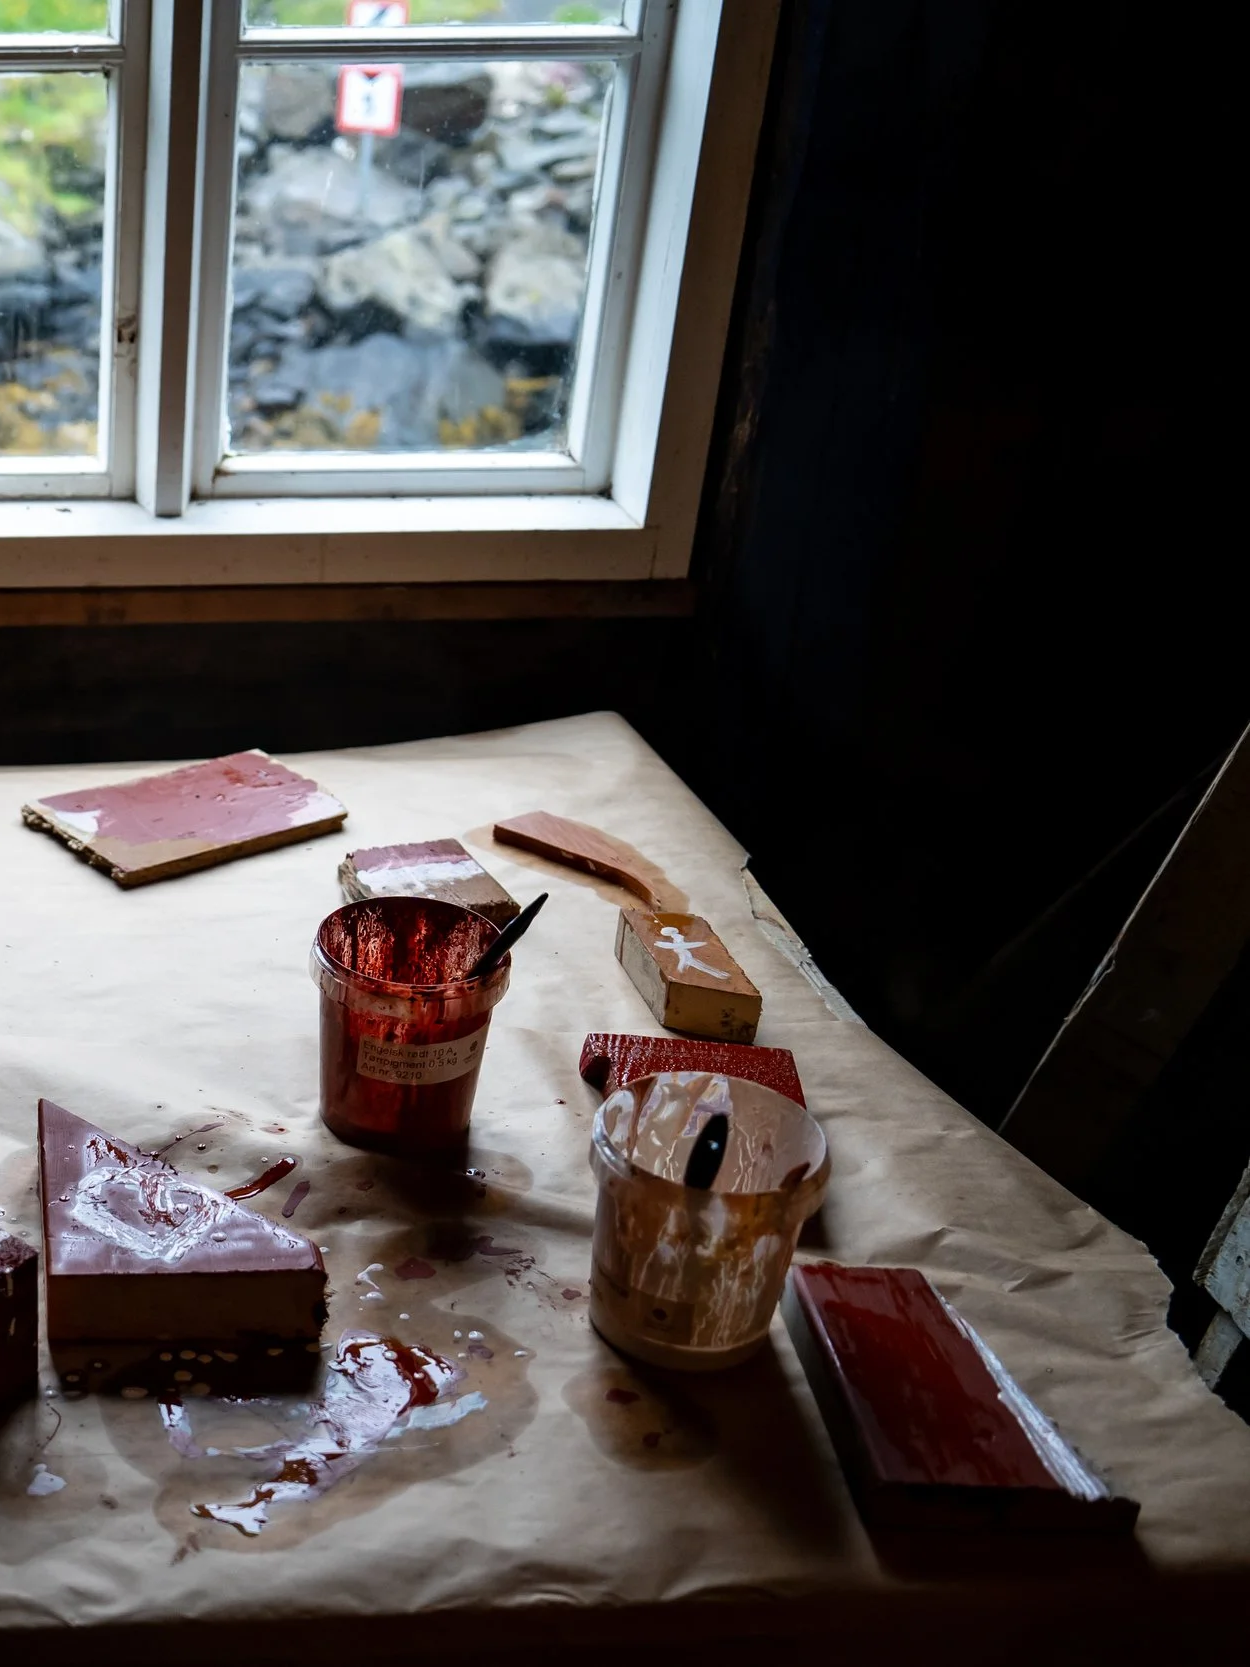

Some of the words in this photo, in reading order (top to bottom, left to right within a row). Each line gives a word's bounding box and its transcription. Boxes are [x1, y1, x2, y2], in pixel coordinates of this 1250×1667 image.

[363, 1040, 403, 1056] Engelsk
[407, 1050, 429, 1058] rødt
[363, 1051, 426, 1070] Tørrpigment
[447, 1057, 458, 1067] kg
[396, 1070, 423, 1080] 9210
